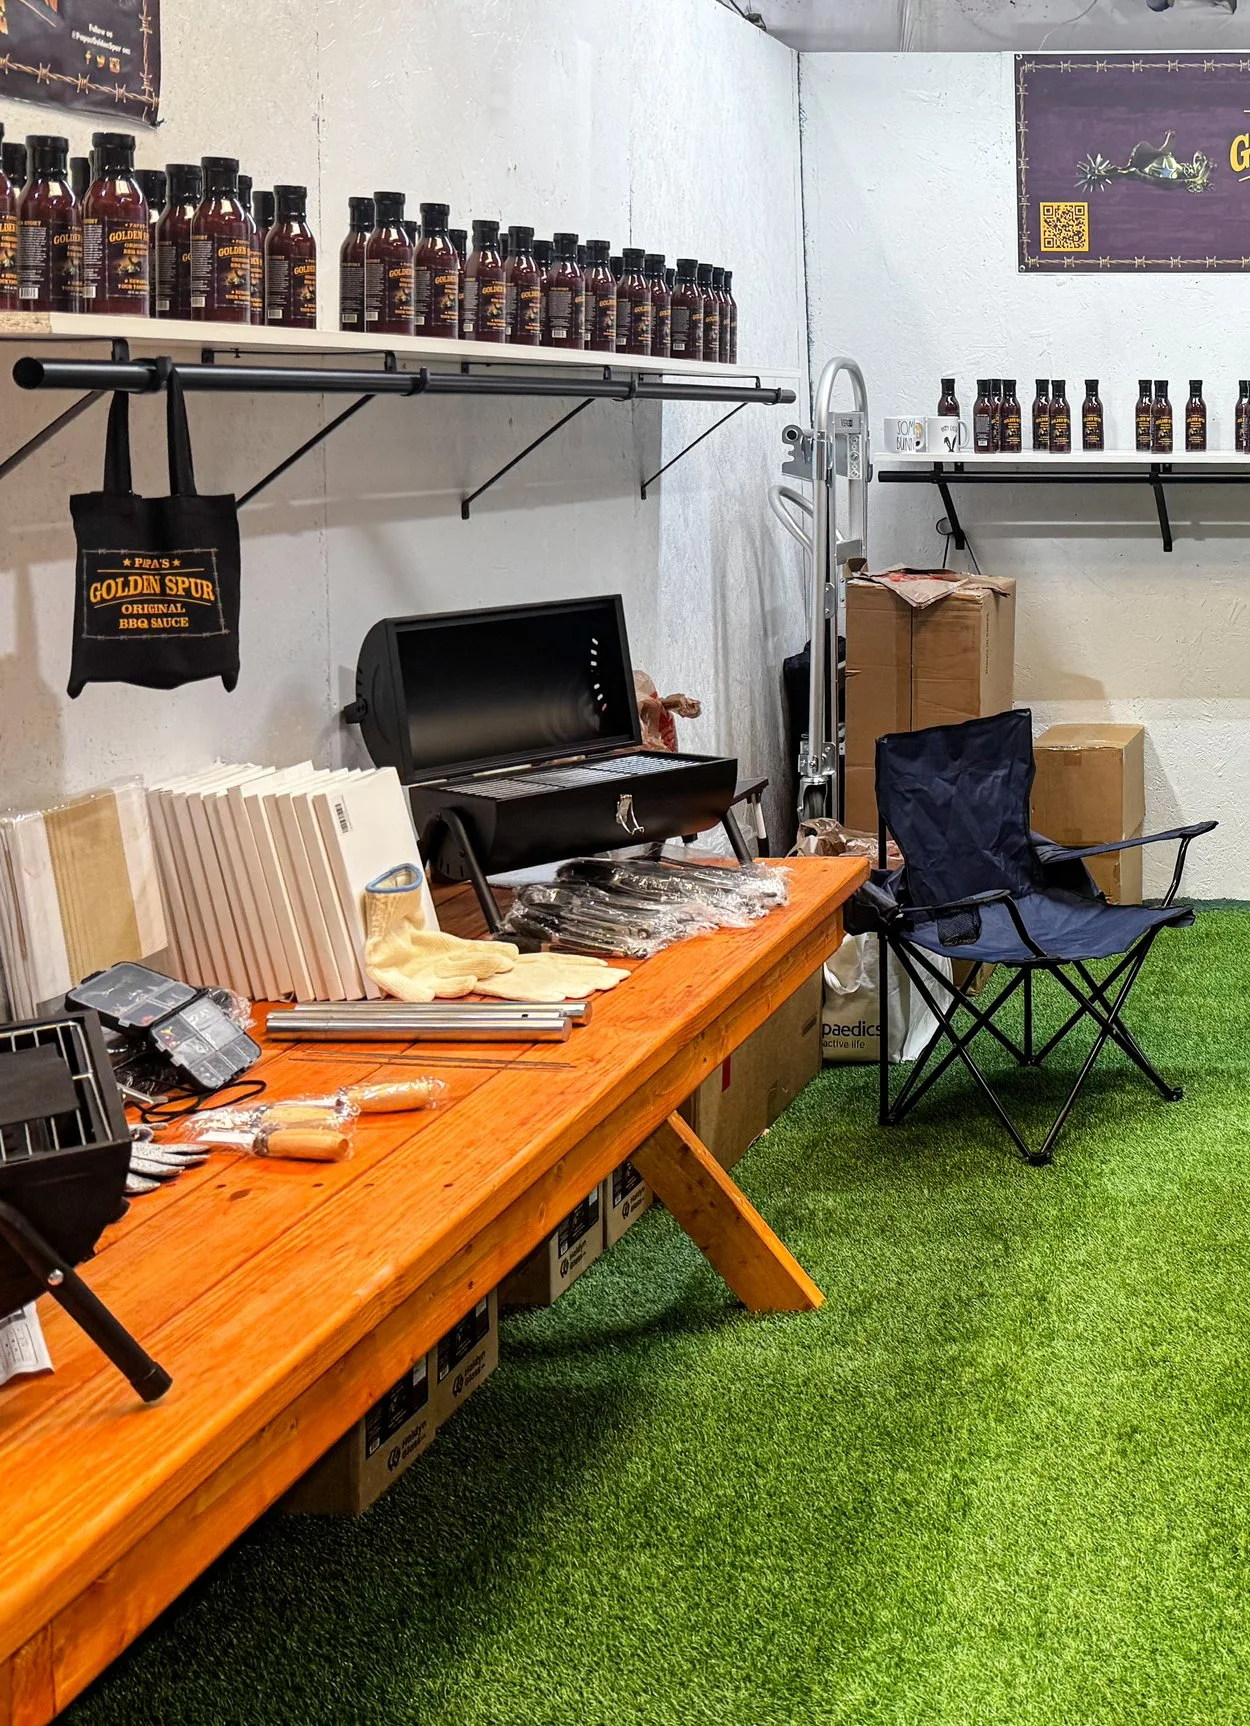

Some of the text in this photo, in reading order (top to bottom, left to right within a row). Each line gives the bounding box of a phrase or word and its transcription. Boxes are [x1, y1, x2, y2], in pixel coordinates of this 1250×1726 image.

[89, 575, 216, 603] GOLDEN SPUR
[121, 603, 186, 614] ORIGINAL
[119, 617, 189, 629] BBQ SAUCE
[822, 1021, 881, 1038] paedics
[851, 1039, 866, 1049] life
